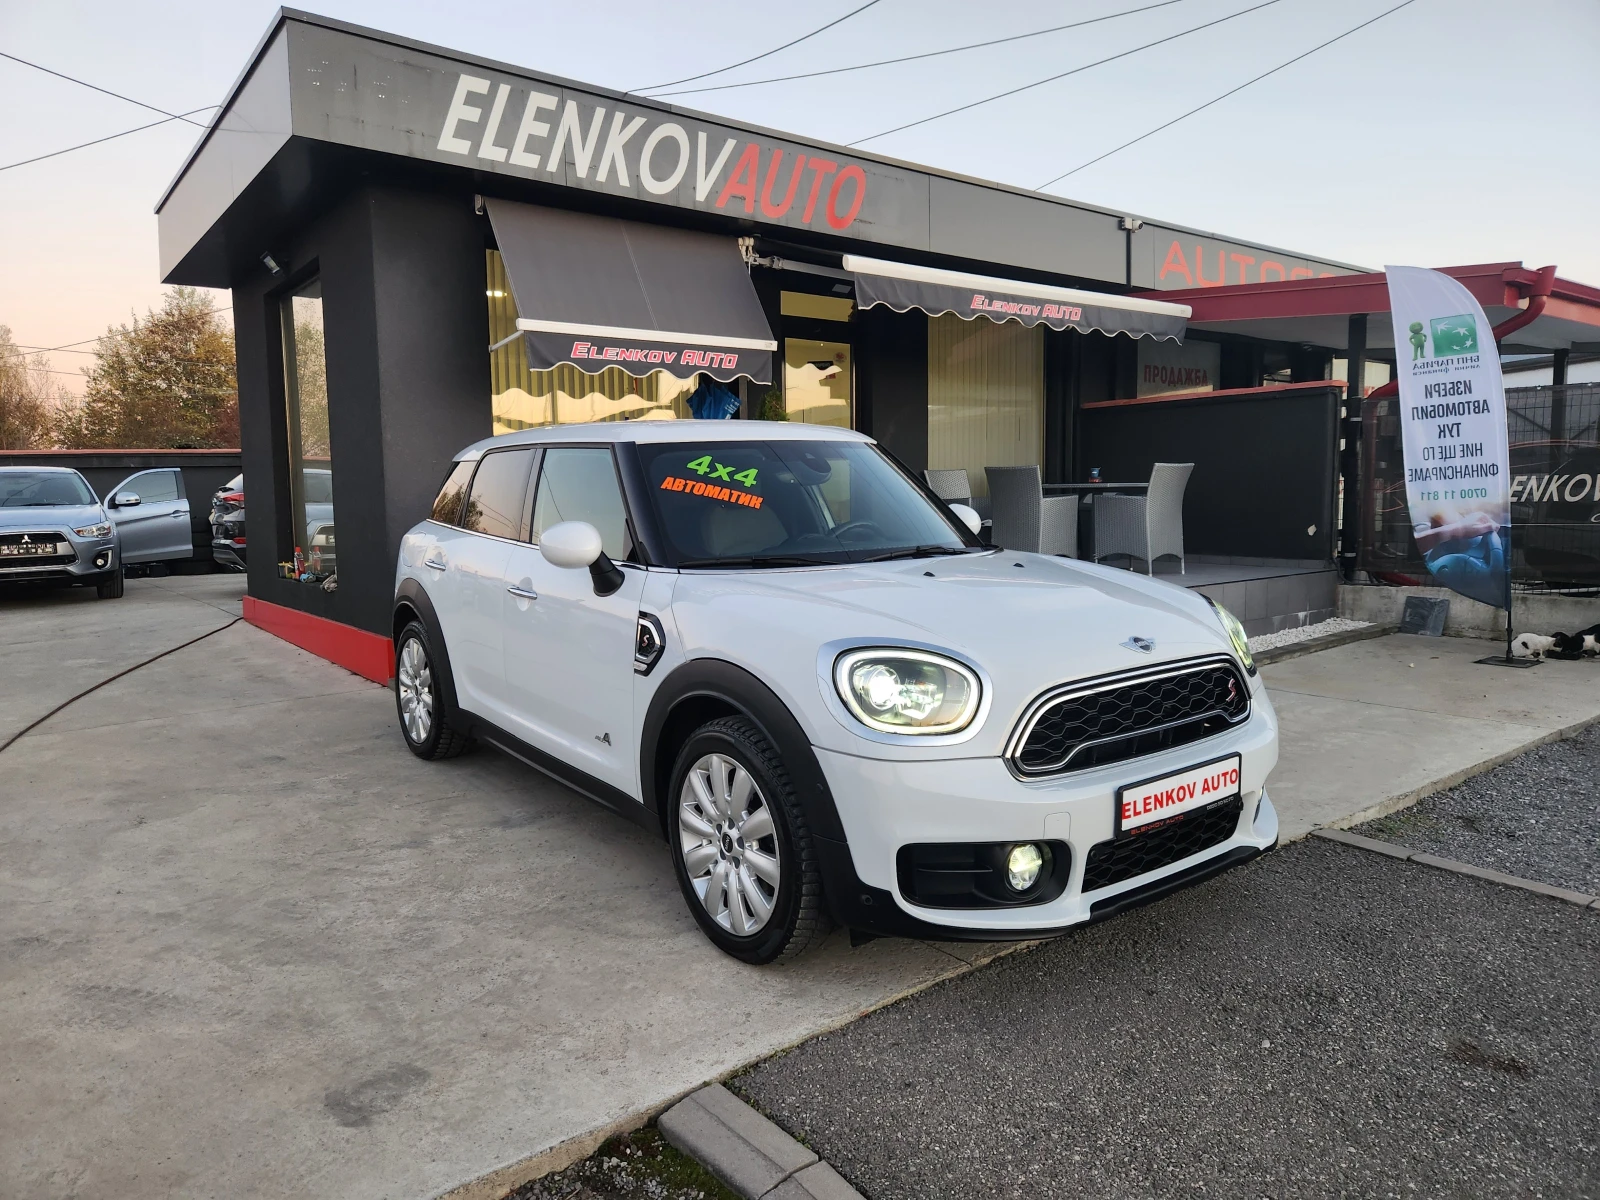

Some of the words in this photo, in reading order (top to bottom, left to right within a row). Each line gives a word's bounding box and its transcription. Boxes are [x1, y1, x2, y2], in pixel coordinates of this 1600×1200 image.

[970, 294, 1041, 316] ELENKOV
[1042, 303, 1082, 321] AUTO
[571, 341, 678, 364] ELENKOV
[680, 349, 739, 369] AUTO
[1144, 364, 1209, 387] ПРОДАЖБА
[686, 455, 759, 488] 4x4
[660, 476, 764, 509] АВТОМАТИК
[1121, 781, 1197, 820] ELENKOV
[1201, 768, 1239, 796] AUTO
